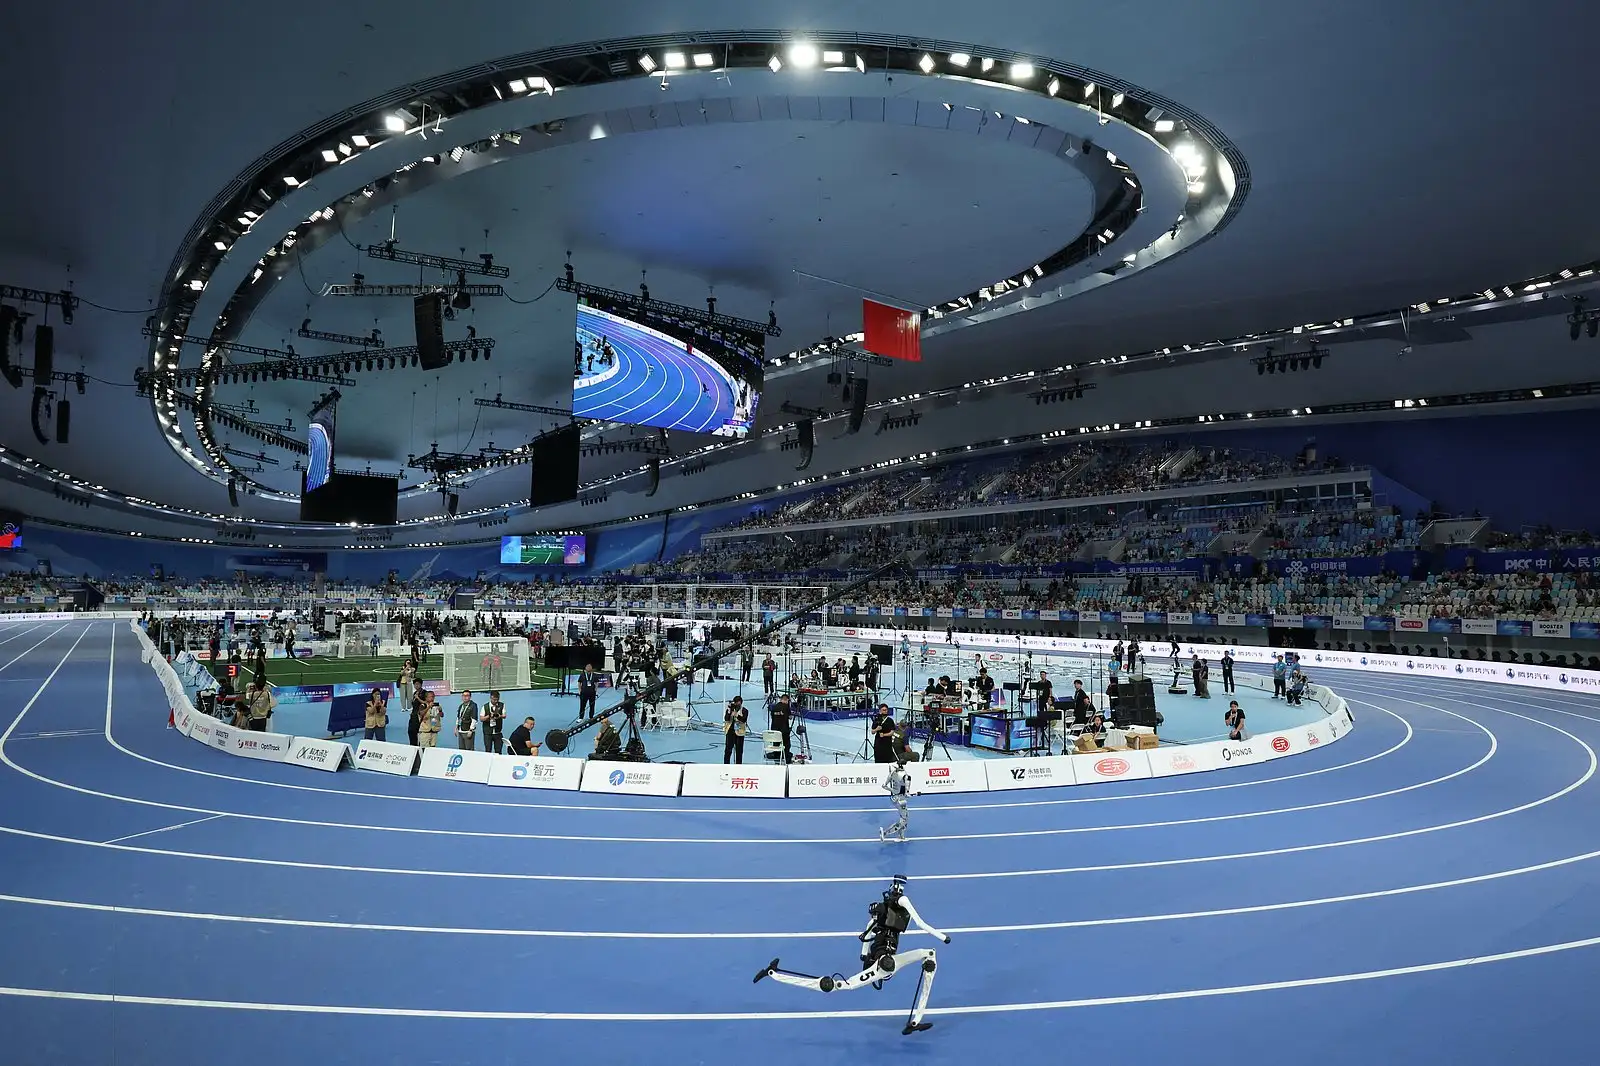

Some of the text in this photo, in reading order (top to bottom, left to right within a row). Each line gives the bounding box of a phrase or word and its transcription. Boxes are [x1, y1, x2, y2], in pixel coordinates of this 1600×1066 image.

[1311, 561, 1347, 571] 中国联通
[1505, 559, 1532, 570] PICC
[228, 665, 236, 676] 3
[260, 743, 281, 751] OptiTrack
[1231, 747, 1253, 758] HONOR
[533, 764, 555, 776] 智元
[1102, 761, 1122, 773] 三元
[1010, 768, 1026, 780] YZ
[730, 777, 760, 790] 京东
[797, 778, 817, 786] ICBC
[833, 776, 878, 785] 中国工商银行
[859, 971, 876, 982] 5
